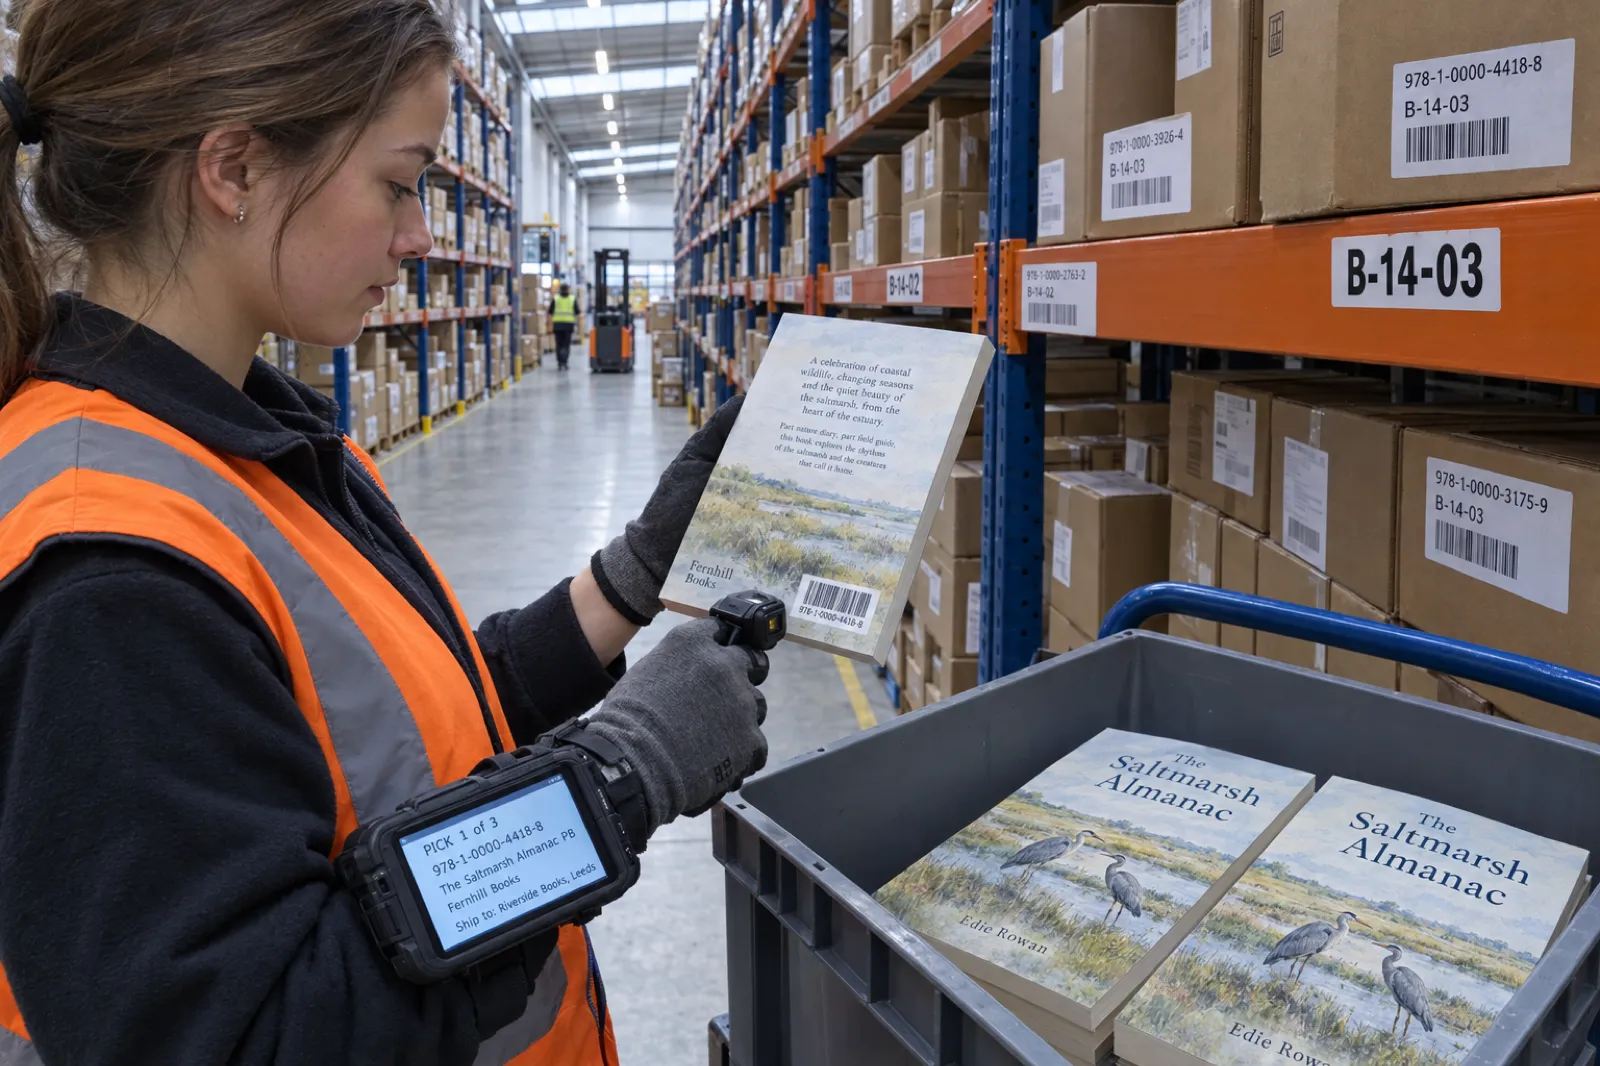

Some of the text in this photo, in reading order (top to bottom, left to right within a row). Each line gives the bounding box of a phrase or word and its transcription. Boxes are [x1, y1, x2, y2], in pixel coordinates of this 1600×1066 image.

[1405, 55, 1542, 89] 978-1-0000-4418-8
[1405, 94, 1469, 118] B-14-03
[1109, 128, 1183, 155] 978-1-0000-3926-4
[1110, 158, 1145, 178] B-14-03
[1347, 241, 1483, 298] B-14-03
[889, 273, 920, 296] B-14-02
[800, 368, 914, 390] wildlife, changing seasons
[820, 358, 866, 372] celebration
[869, 364, 879, 372] of
[880, 366, 912, 377] coastal
[800, 393, 900, 415] the saltmarsh, from the
[802, 382, 905, 403] and the quiet beauty of
[802, 406, 884, 428] heart of the estuary.
[1435, 470, 1548, 513] 978-1-0000-3175-9
[1435, 494, 1484, 524] B-14-03
[685, 572, 717, 590] Books
[689, 559, 734, 581] Fernhill
[1172, 753, 1207, 769] The
[1109, 755, 1261, 807] Saltmarsh
[1094, 773, 1233, 822] Almanac
[423, 816, 499, 857] PICK 1 of 3
[1418, 812, 1457, 834] The
[432, 820, 544, 877] 978-1-0000-4418-8
[439, 828, 576, 896] The Saltmarsh Almanac PB
[1348, 811, 1529, 886] Saltmarsh
[1339, 836, 1507, 906] Almanac
[448, 874, 521, 913] Fernhill Books
[455, 862, 597, 933] Ship to: Riverside Books, Leeds
[960, 914, 1048, 954] Edie Rowan
[1228, 1022, 1272, 1050] Edie
